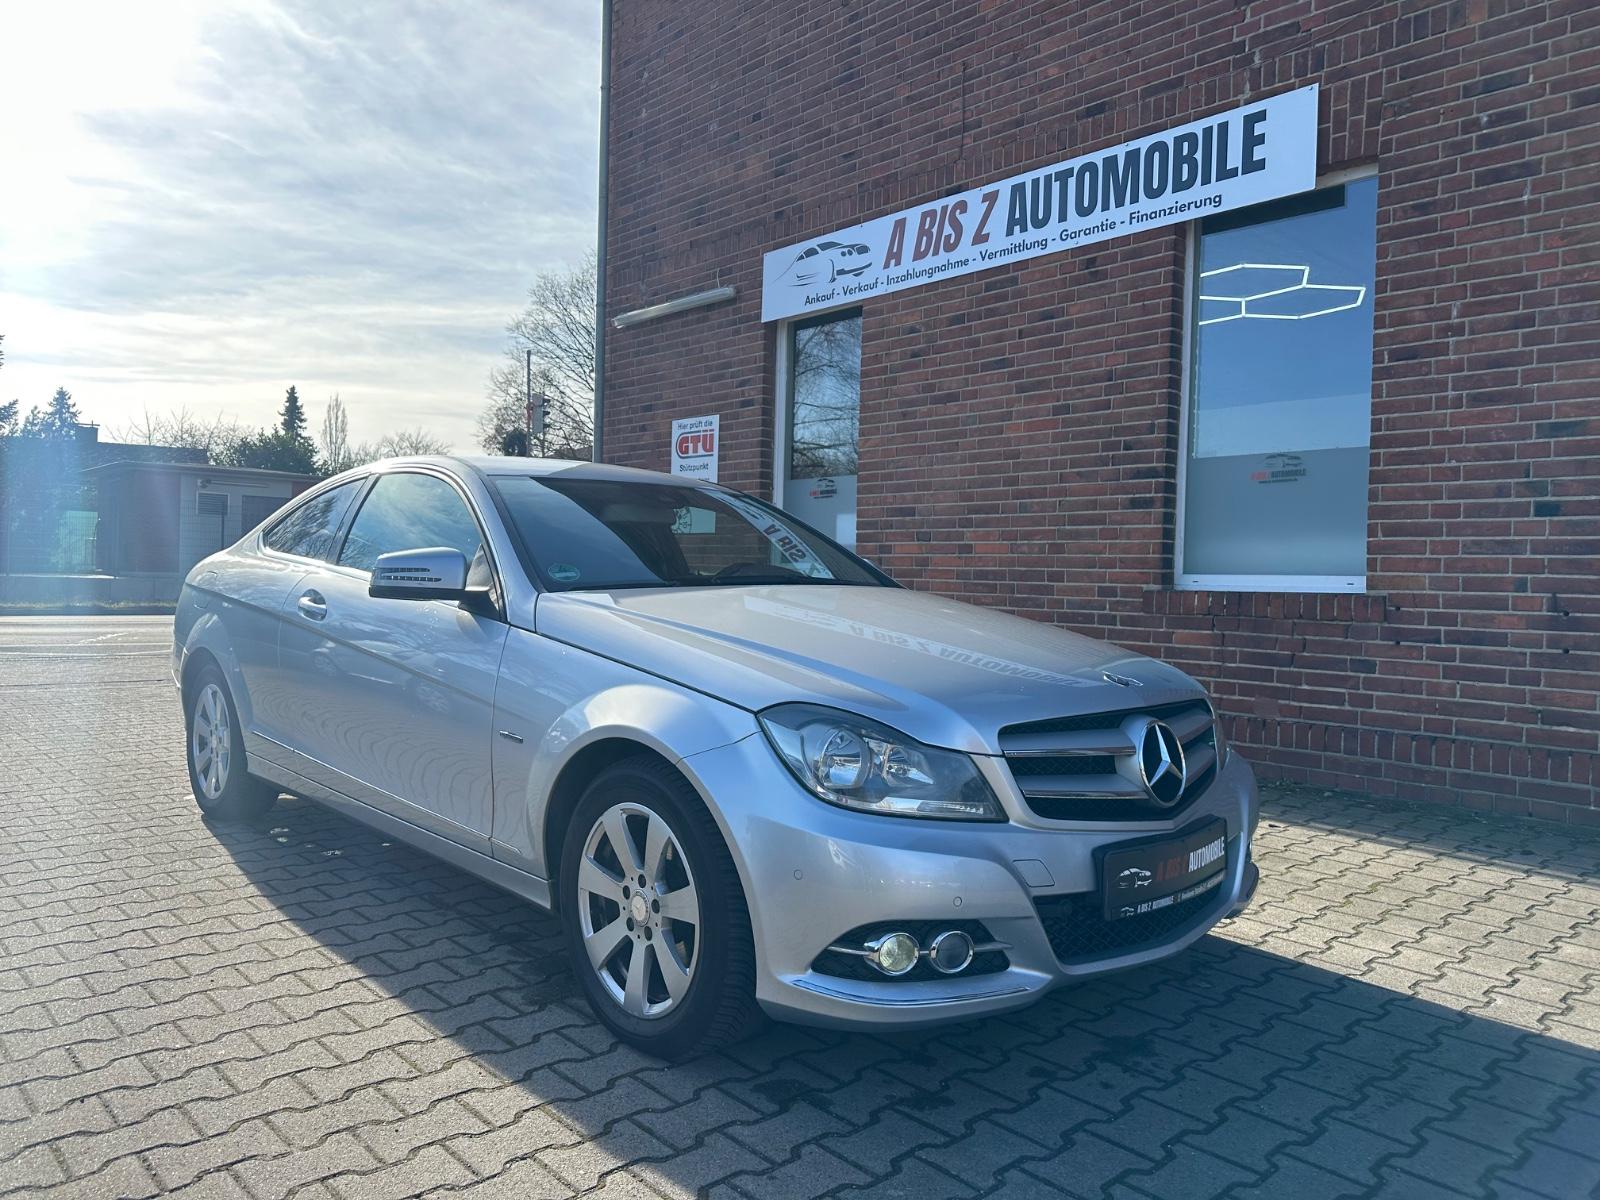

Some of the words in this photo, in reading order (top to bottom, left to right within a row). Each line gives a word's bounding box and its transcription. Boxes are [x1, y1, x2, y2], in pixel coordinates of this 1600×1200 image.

[882, 217, 907, 271] A
[911, 198, 968, 263] BIS
[970, 188, 1000, 247] Z
[1005, 108, 1267, 238] AUTOMOBILE
[804, 288, 836, 306] Ankauf
[842, 277, 879, 297] Verkauf
[886, 257, 970, 286] Inzahlungnahme
[979, 235, 1048, 262] Vermittlung
[1059, 218, 1117, 243] Garantie
[1129, 193, 1222, 226] Finanzierung
[678, 429, 715, 455] GTÜ
[703, 419, 713, 428] die
[1188, 836, 1225, 873] AUTOMOBILE
